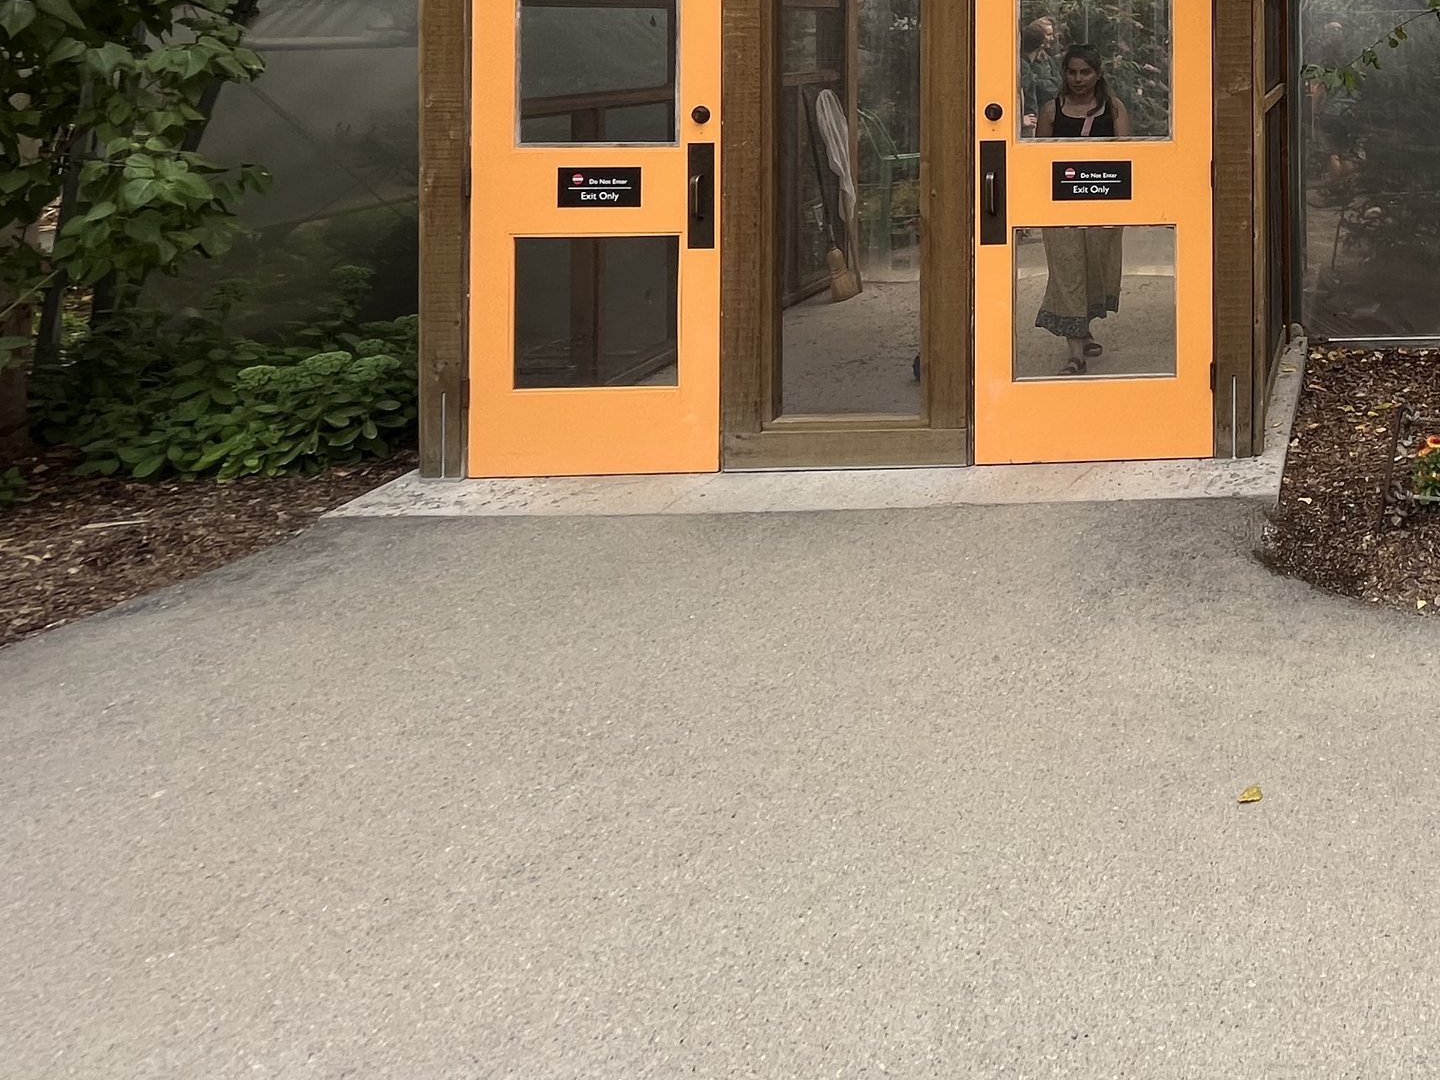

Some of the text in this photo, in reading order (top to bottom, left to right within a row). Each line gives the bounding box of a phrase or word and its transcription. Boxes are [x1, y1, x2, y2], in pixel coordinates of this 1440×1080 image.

[1073, 185, 1109, 195] Exit Only
[581, 191, 619, 201] Exit Only
